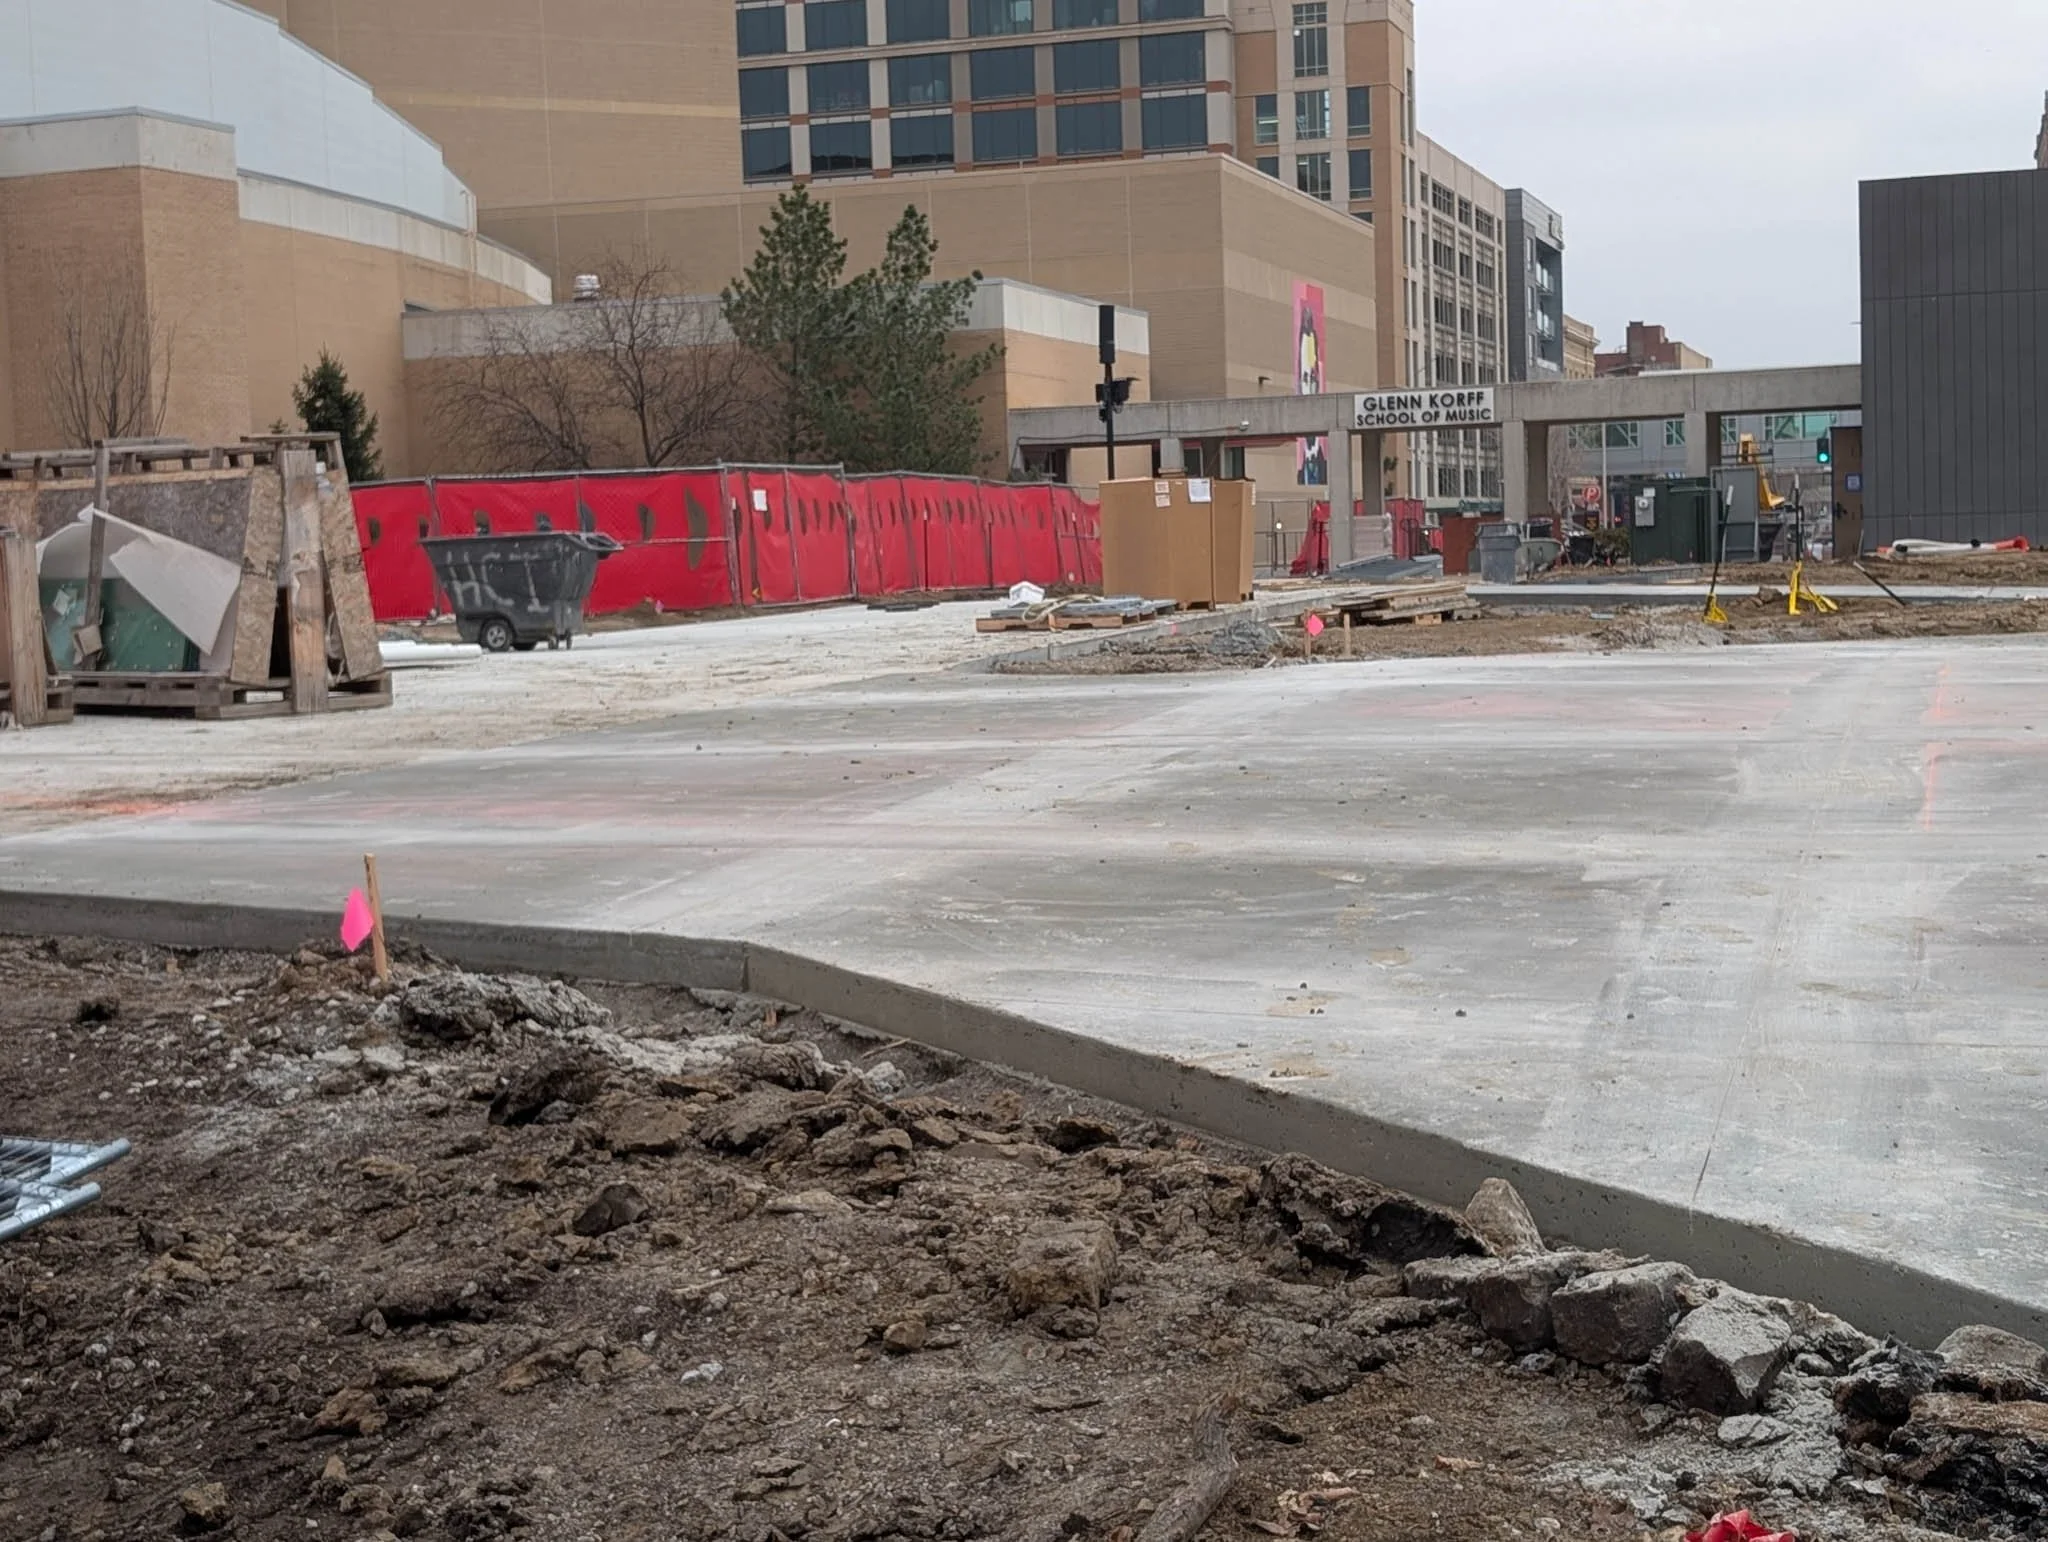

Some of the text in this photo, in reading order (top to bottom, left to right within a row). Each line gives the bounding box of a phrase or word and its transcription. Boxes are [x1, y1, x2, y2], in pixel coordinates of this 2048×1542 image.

[1363, 391, 1485, 412] GLENN KORFF
[1356, 408, 1492, 427] SCHOOL OF MUSIC
